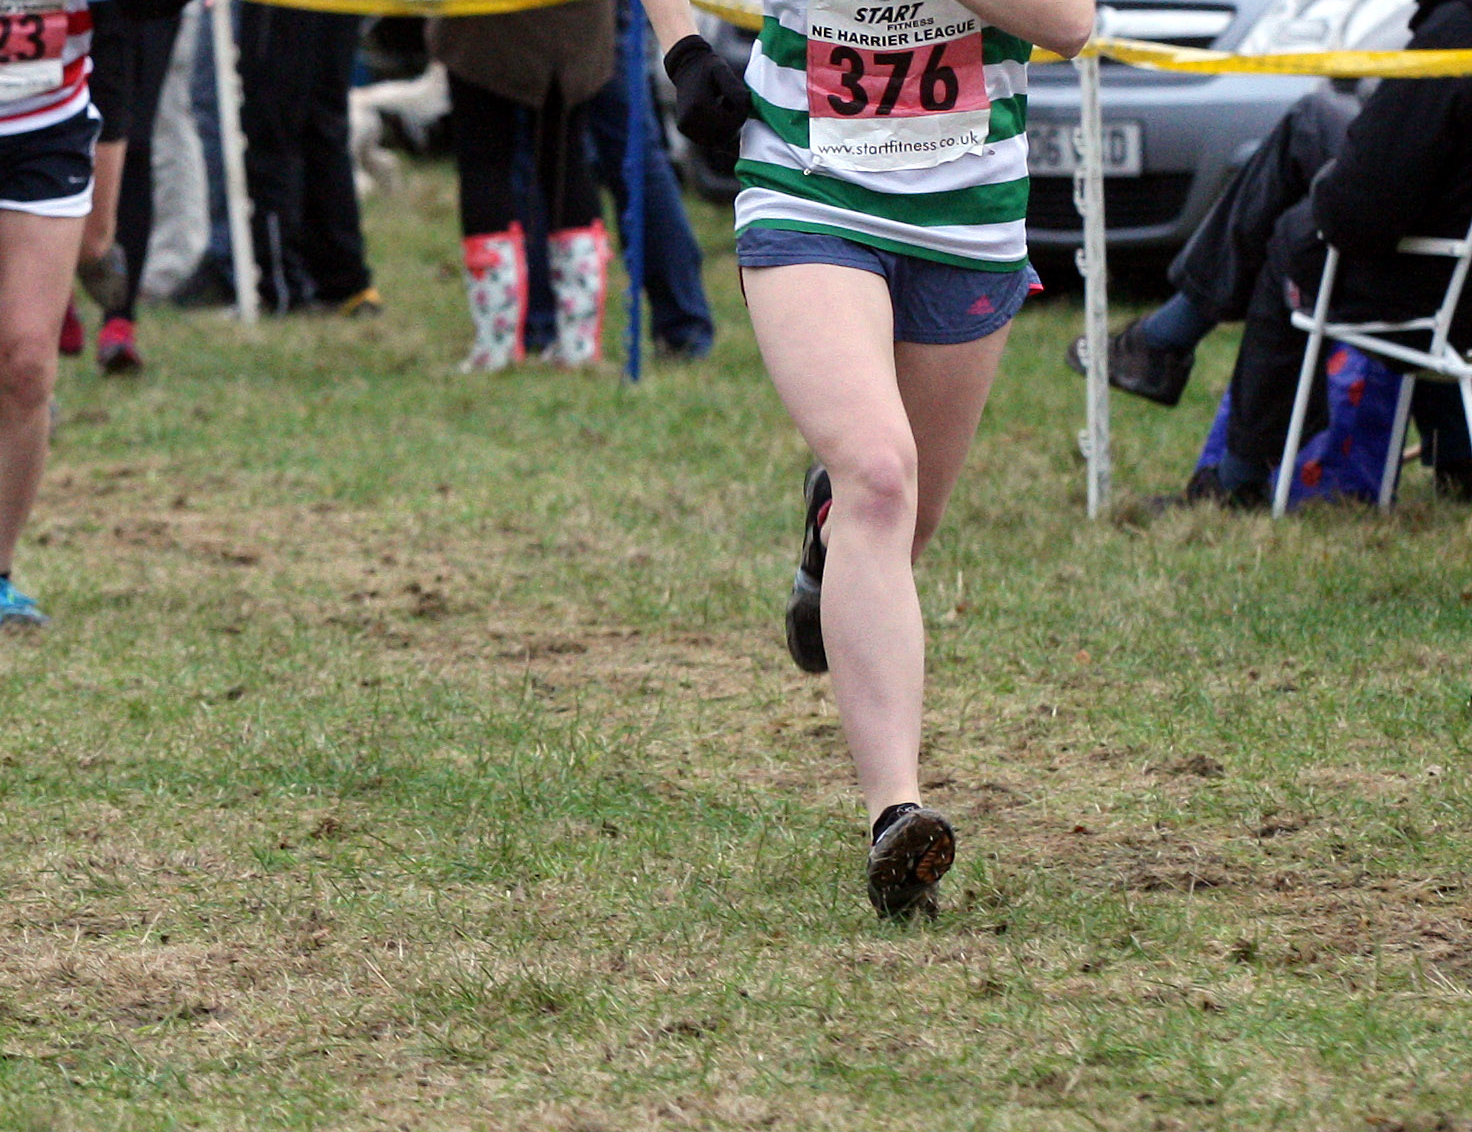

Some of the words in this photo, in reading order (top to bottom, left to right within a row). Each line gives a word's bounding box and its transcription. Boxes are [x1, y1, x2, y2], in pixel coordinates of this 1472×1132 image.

[854, 2, 924, 24] START
[887, 18, 934, 31] FITNESS
[812, 25, 833, 39] NE
[838, 30, 909, 47] HARRIER
[915, 19, 975, 43] LEAGUE
[827, 42, 959, 116] 376
